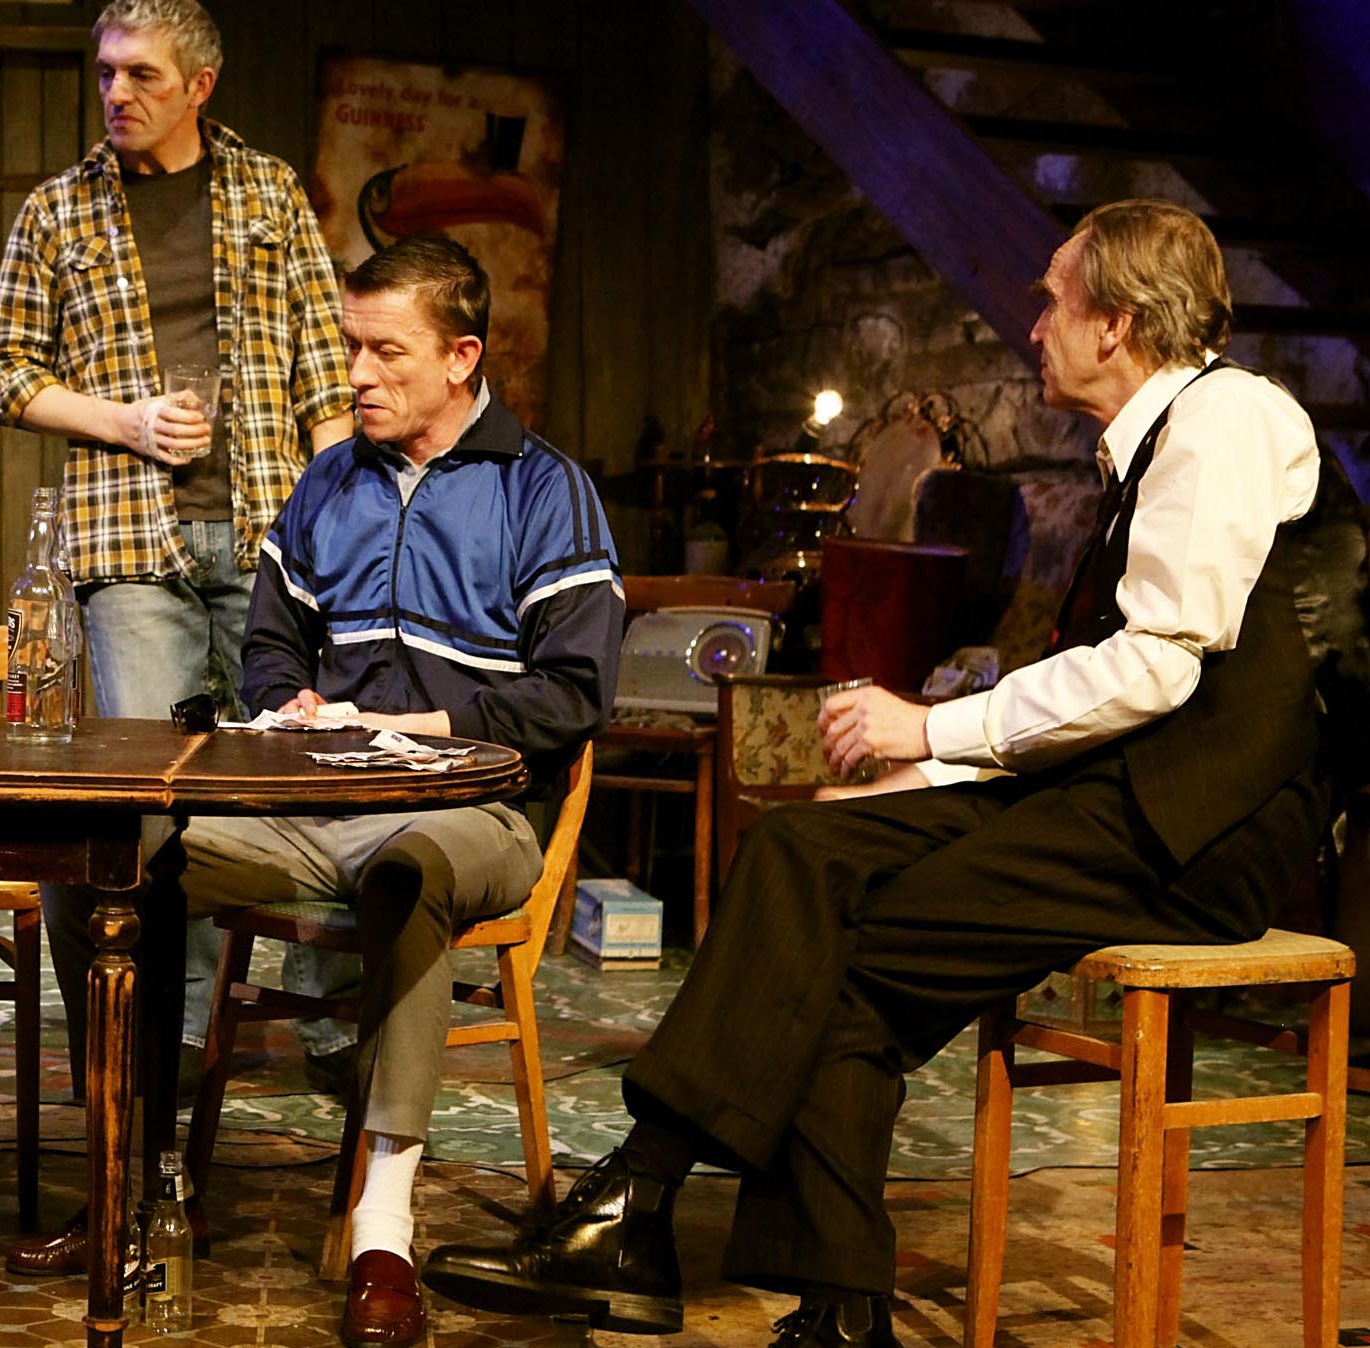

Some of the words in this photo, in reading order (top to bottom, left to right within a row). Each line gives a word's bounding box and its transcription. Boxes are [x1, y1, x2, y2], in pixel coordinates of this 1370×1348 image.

[341, 79, 393, 100] Lovely
[400, 85, 432, 105] day
[336, 103, 426, 132] GUINNESS
